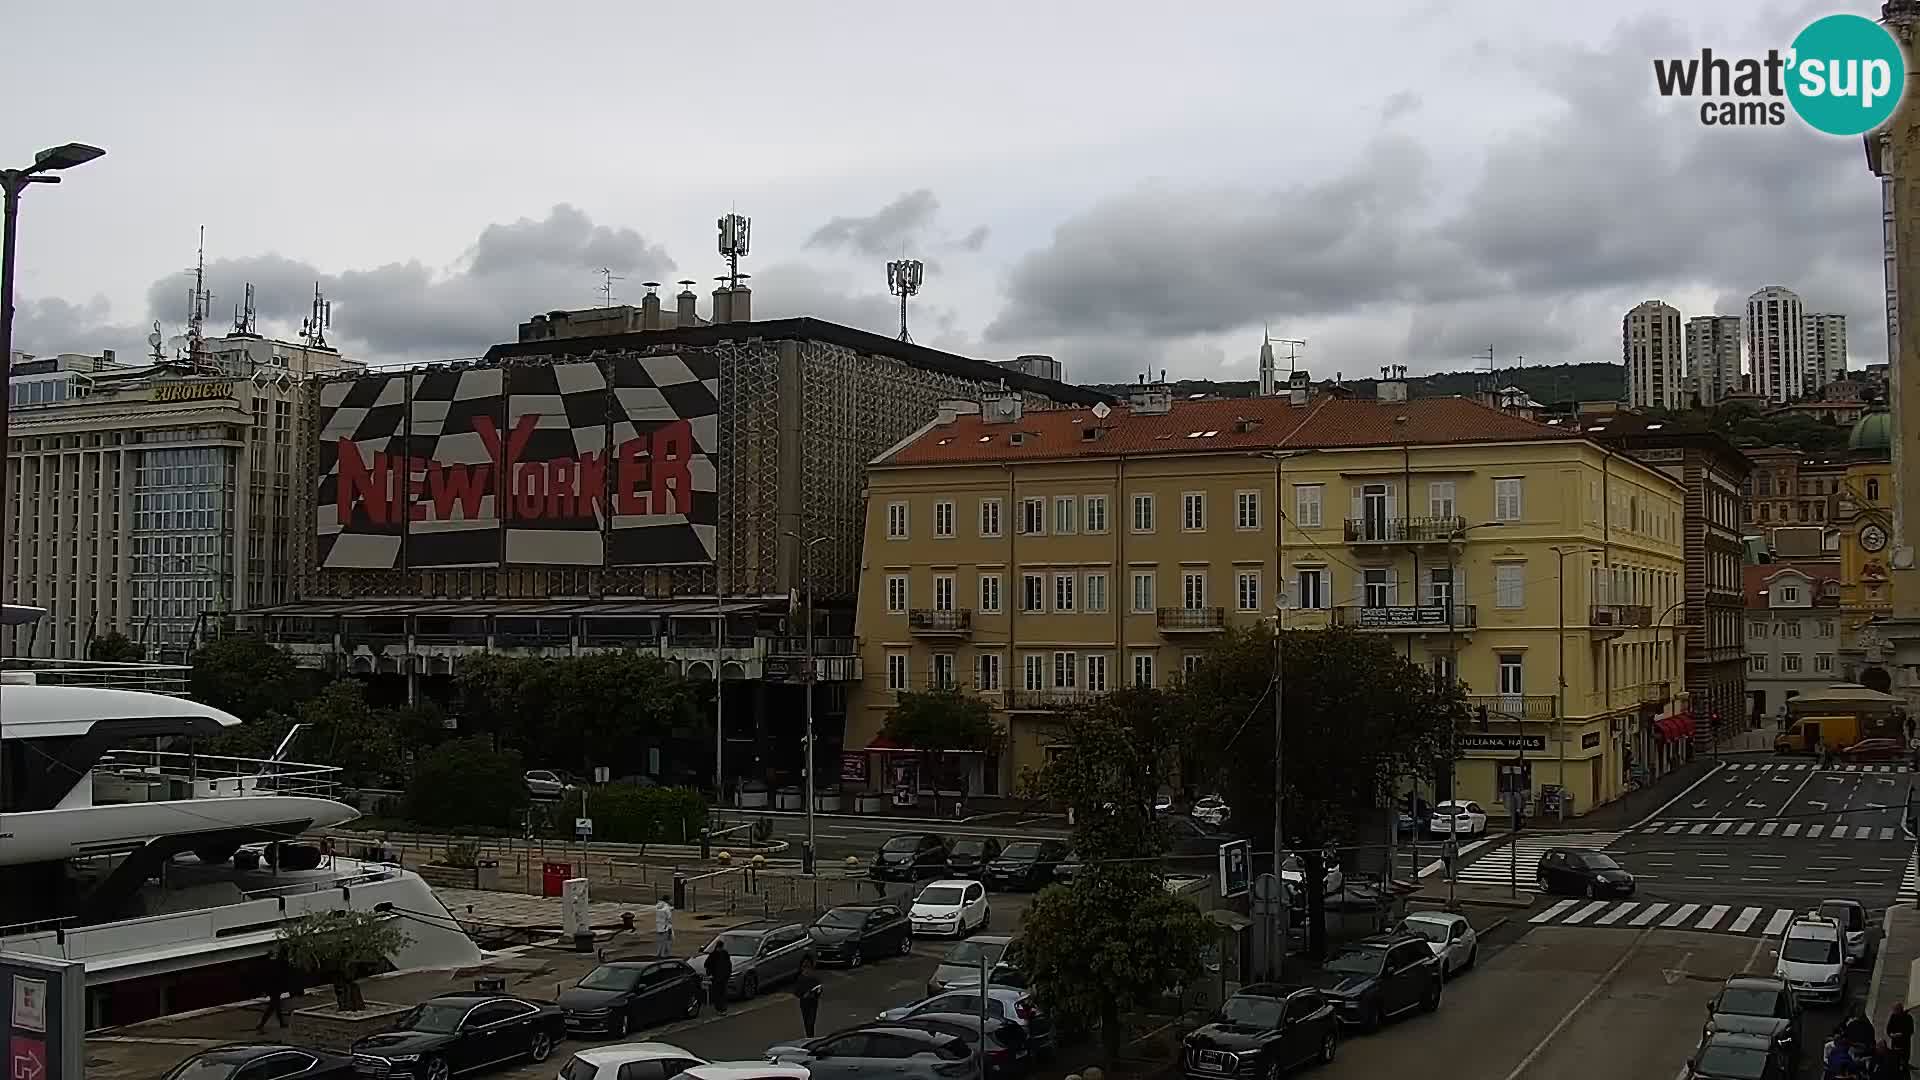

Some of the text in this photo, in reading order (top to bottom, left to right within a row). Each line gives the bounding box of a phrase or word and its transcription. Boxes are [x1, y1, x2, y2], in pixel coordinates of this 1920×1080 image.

[337, 414, 694, 527] NEW YORKER
[1459, 737, 1542, 748] JULIANA NAILS
